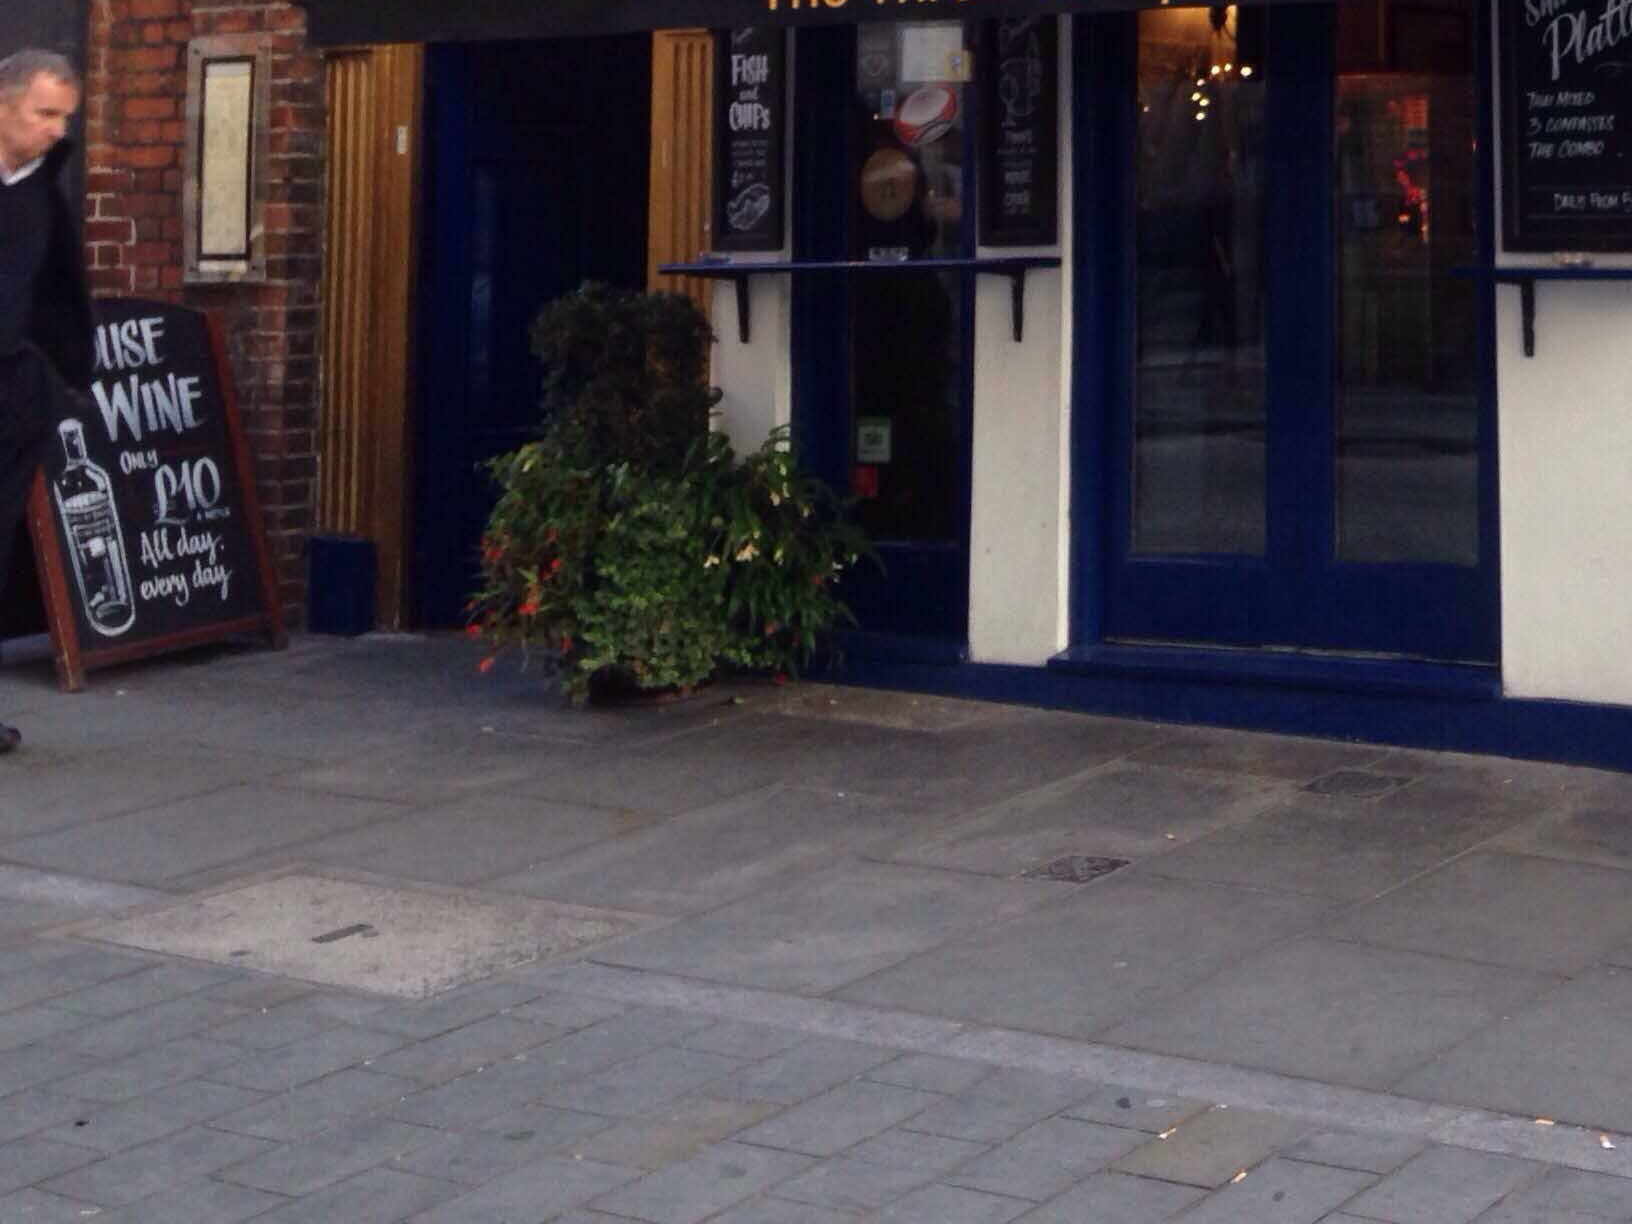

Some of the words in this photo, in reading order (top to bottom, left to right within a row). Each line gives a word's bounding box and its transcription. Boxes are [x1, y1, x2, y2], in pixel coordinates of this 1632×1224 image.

[731, 53, 769, 87] FISH
[93, 317, 165, 372] USE
[91, 373, 203, 442] WINE
[154, 456, 220, 525] £10
[141, 527, 175, 569] All
[141, 573, 190, 607] every
[192, 559, 232, 600] day
